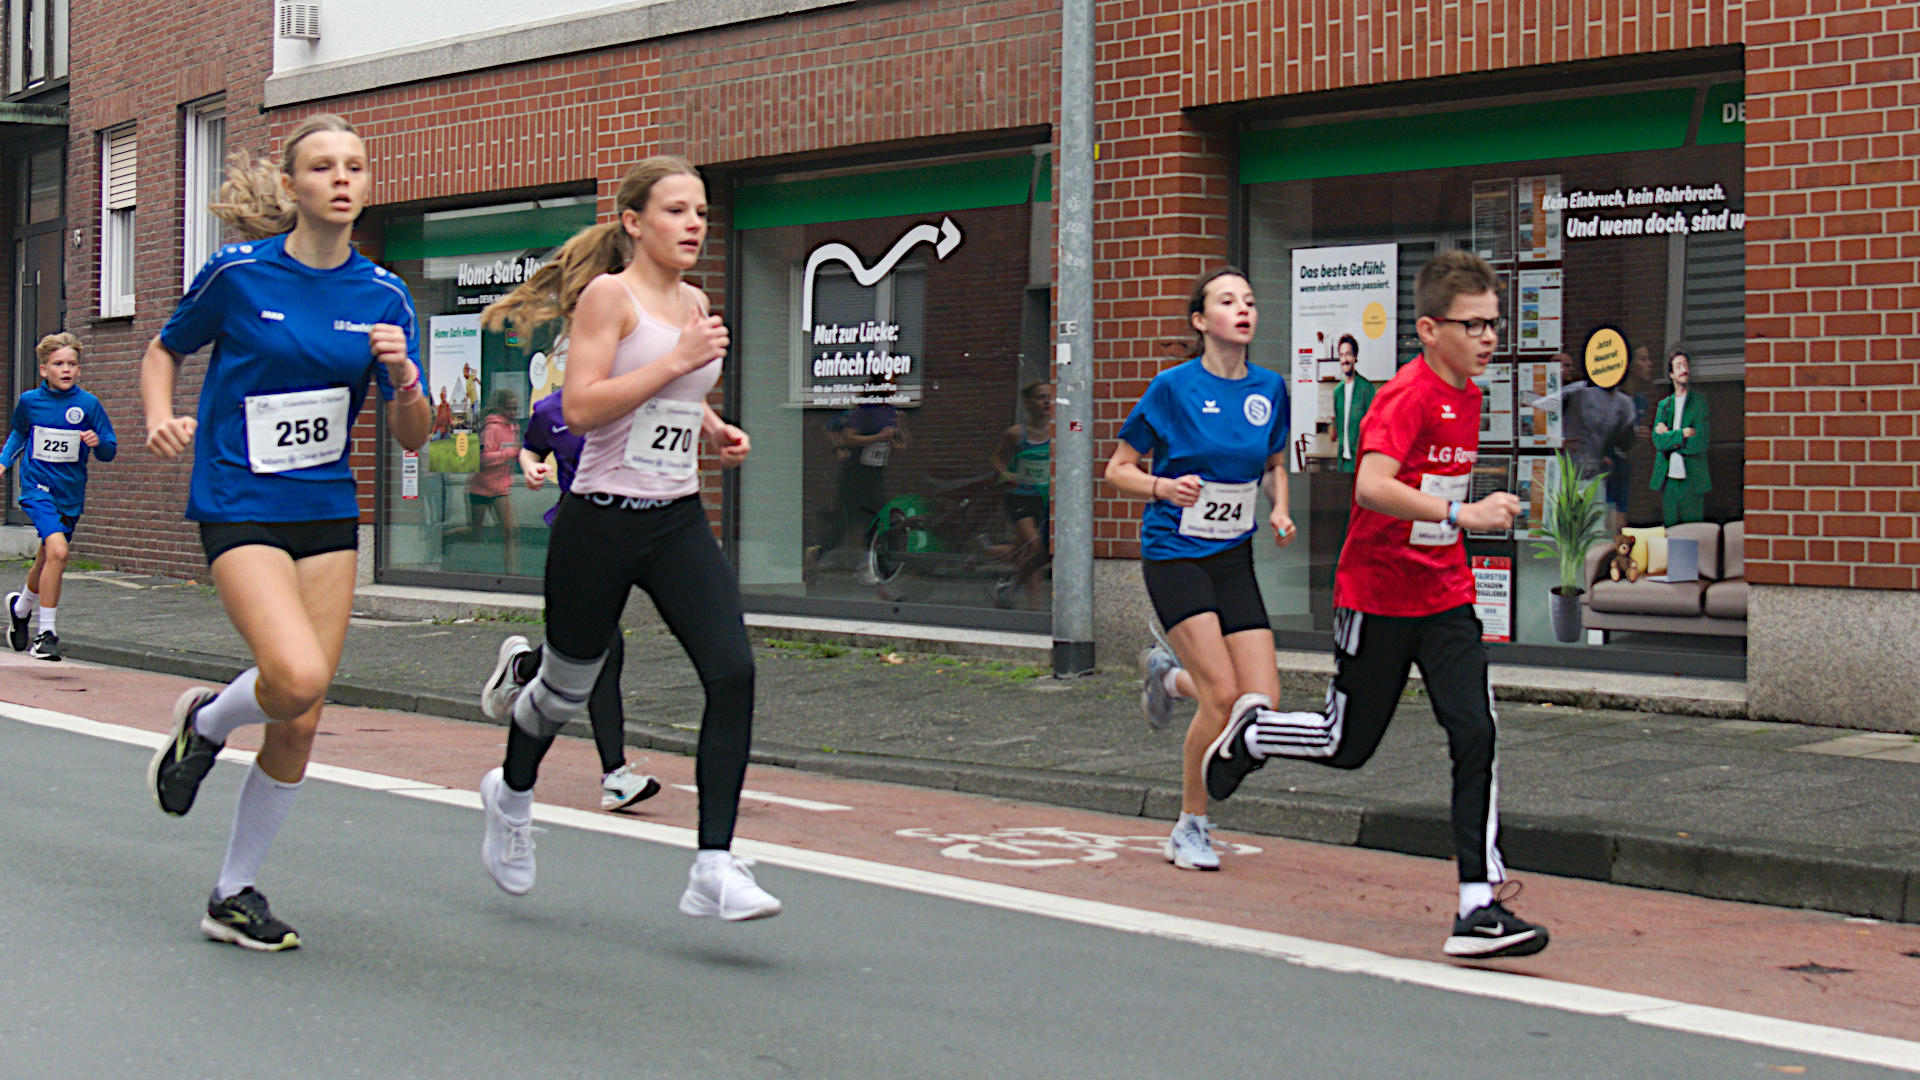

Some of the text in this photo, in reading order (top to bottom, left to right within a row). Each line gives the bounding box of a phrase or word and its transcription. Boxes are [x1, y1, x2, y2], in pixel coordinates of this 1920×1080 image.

[1542, 183, 1726, 210] Kein Einbruch, kein Rohrbruch.
[1567, 215, 1599, 238] Und
[1600, 218, 1643, 237] wenn
[1645, 211, 1689, 235] doch,
[1691, 208, 1730, 232] sind
[458, 263, 492, 286] Home
[494, 257, 523, 284] Safe
[1300, 260, 1386, 279] Das beste Gefühl:
[1317, 281, 1341, 292] einfach
[1341, 280, 1361, 291] nichts
[1361, 279, 1390, 291] passiert.
[434, 327, 477, 339] Home Safe Home
[814, 320, 899, 345] Mut zur Lücke:
[1596, 339, 1612, 350] Jetzt
[813, 350, 911, 380] einfach folgen
[1593, 350, 1618, 362] Hausrat
[276, 417, 329, 447] 258
[651, 425, 692, 453] 270
[43, 439, 69, 453] 225
[1428, 444, 1453, 463] LG
[1203, 501, 1243, 522] 224
[1474, 572, 1508, 582] FAIRSTER
[1476, 582, 1505, 590] SCHADEN-
